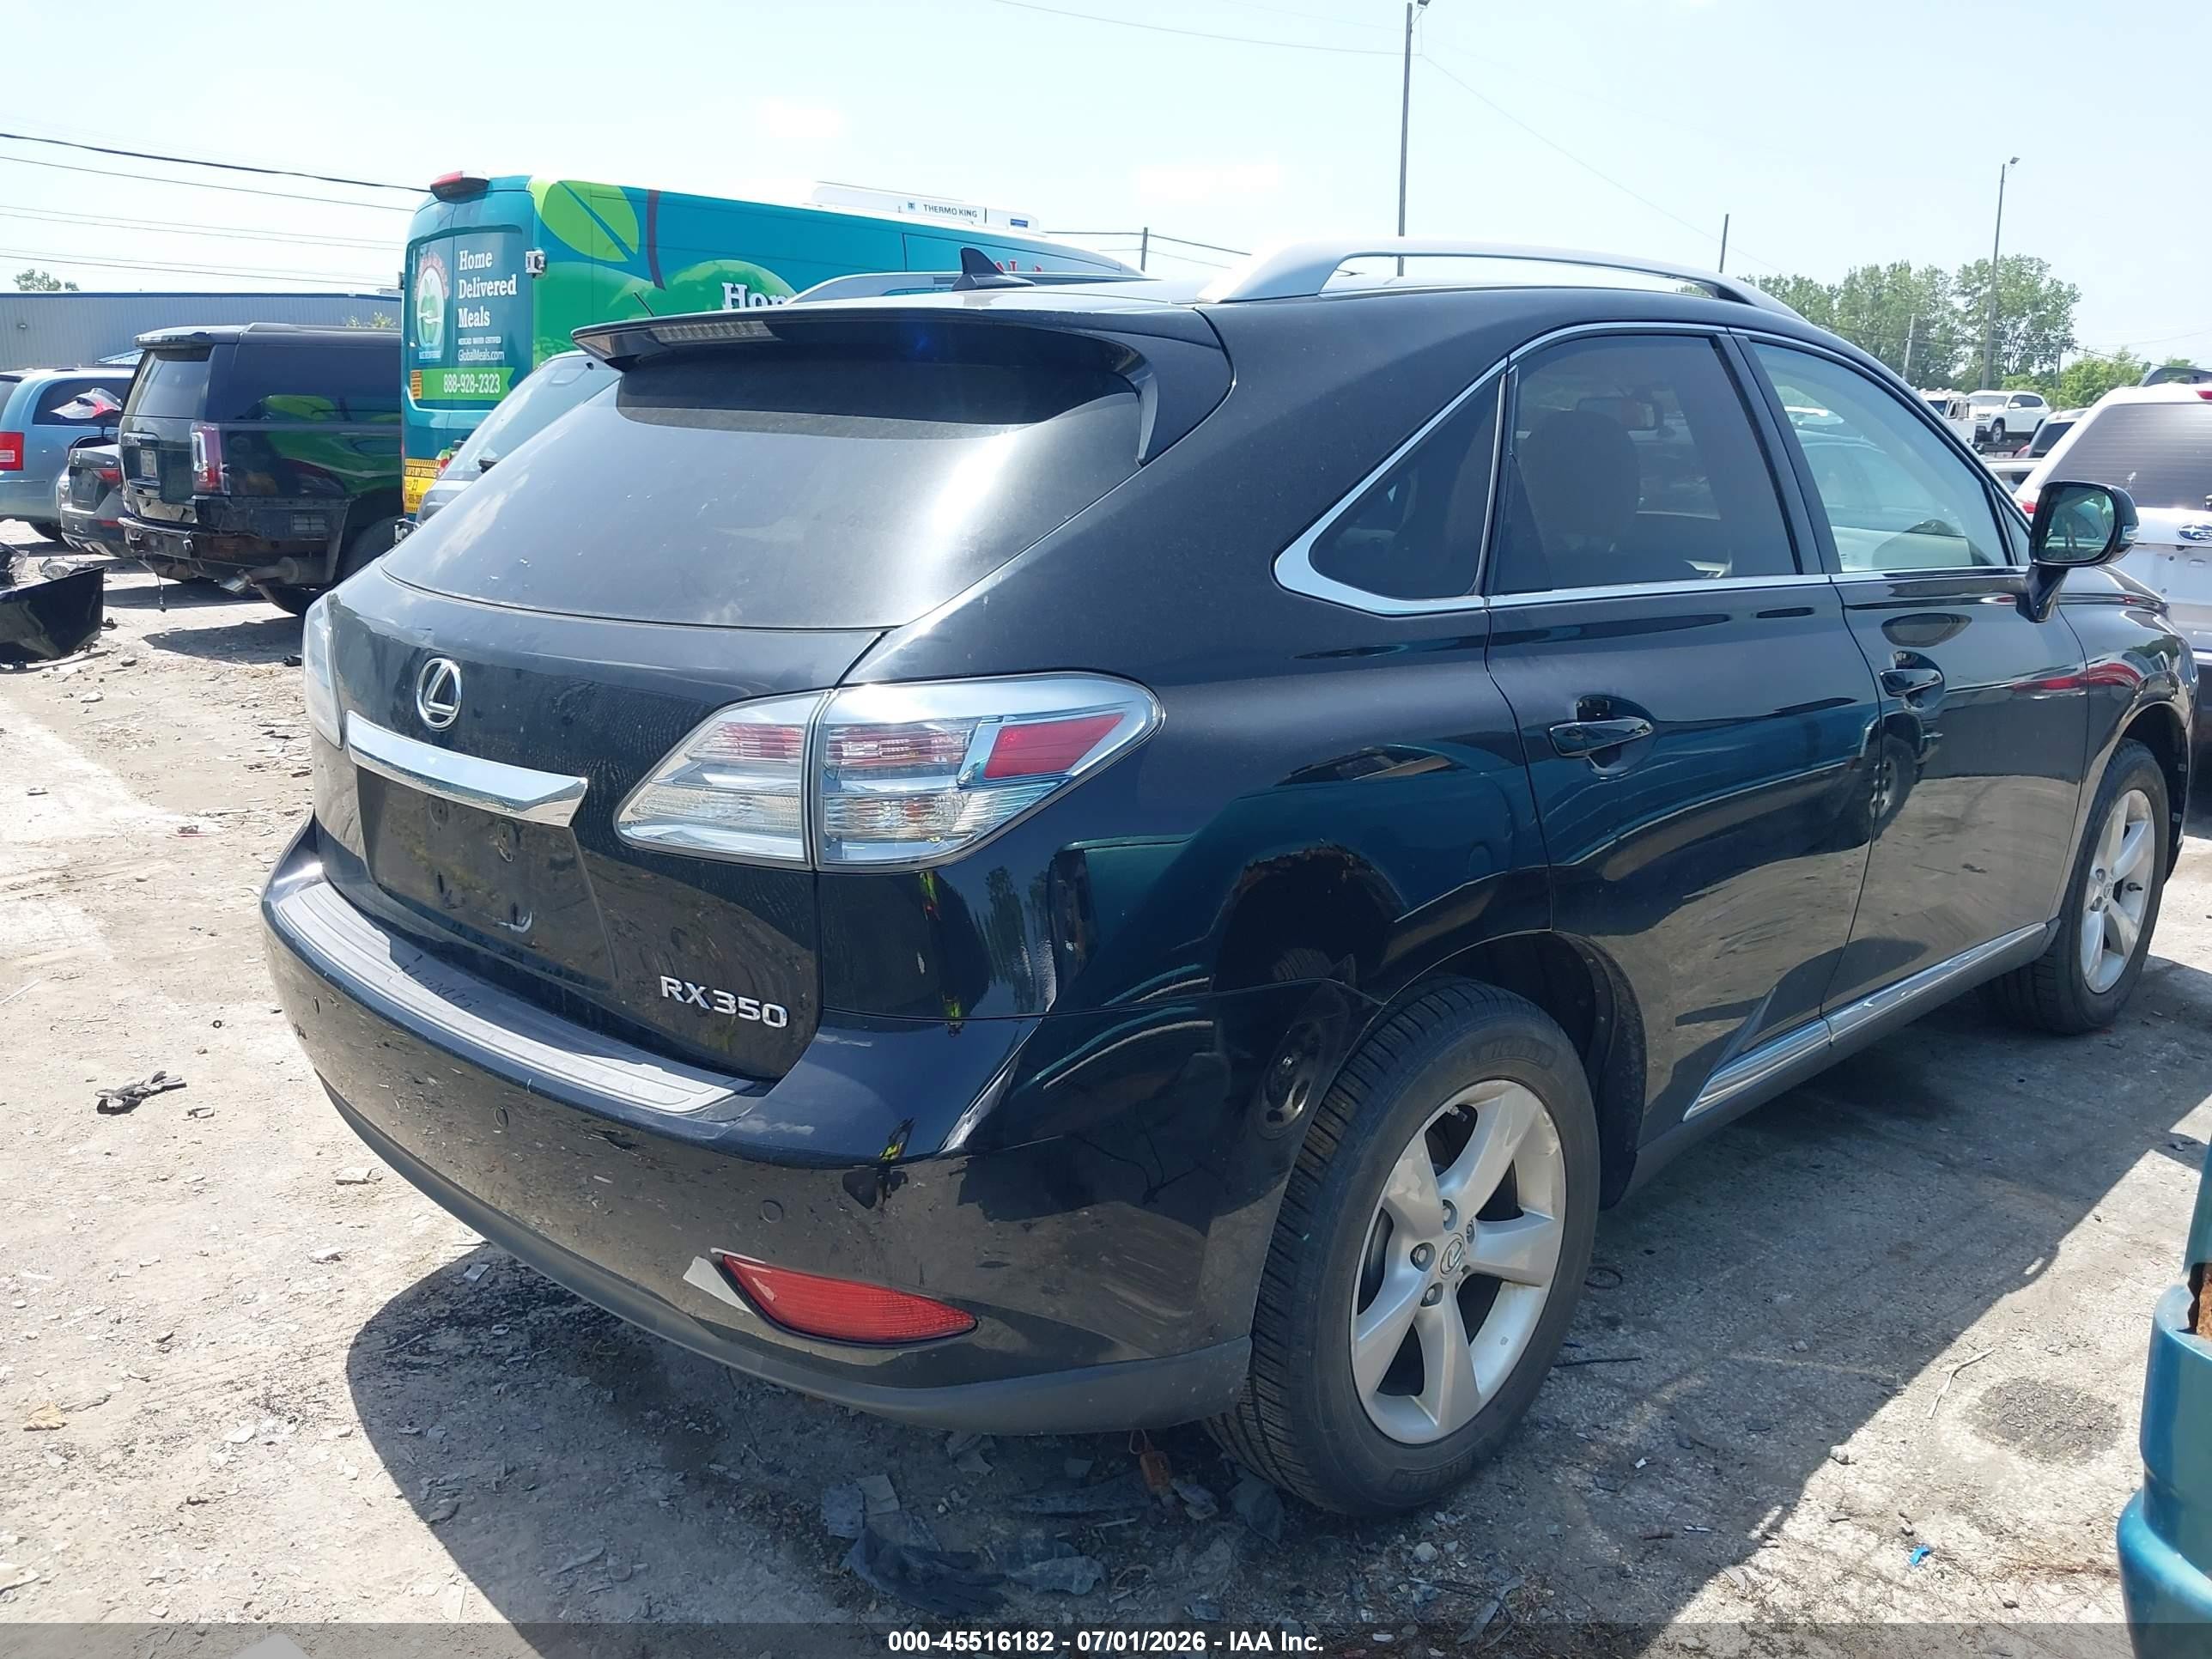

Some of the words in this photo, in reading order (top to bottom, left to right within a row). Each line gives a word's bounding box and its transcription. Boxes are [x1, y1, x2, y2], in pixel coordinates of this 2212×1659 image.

[923, 204, 957, 216] THERMO
[958, 209, 977, 218] KING
[459, 250, 493, 270] Home
[458, 273, 518, 299] Delivered
[458, 306, 490, 328] Meals
[443, 373, 501, 394] 888-928-2323
